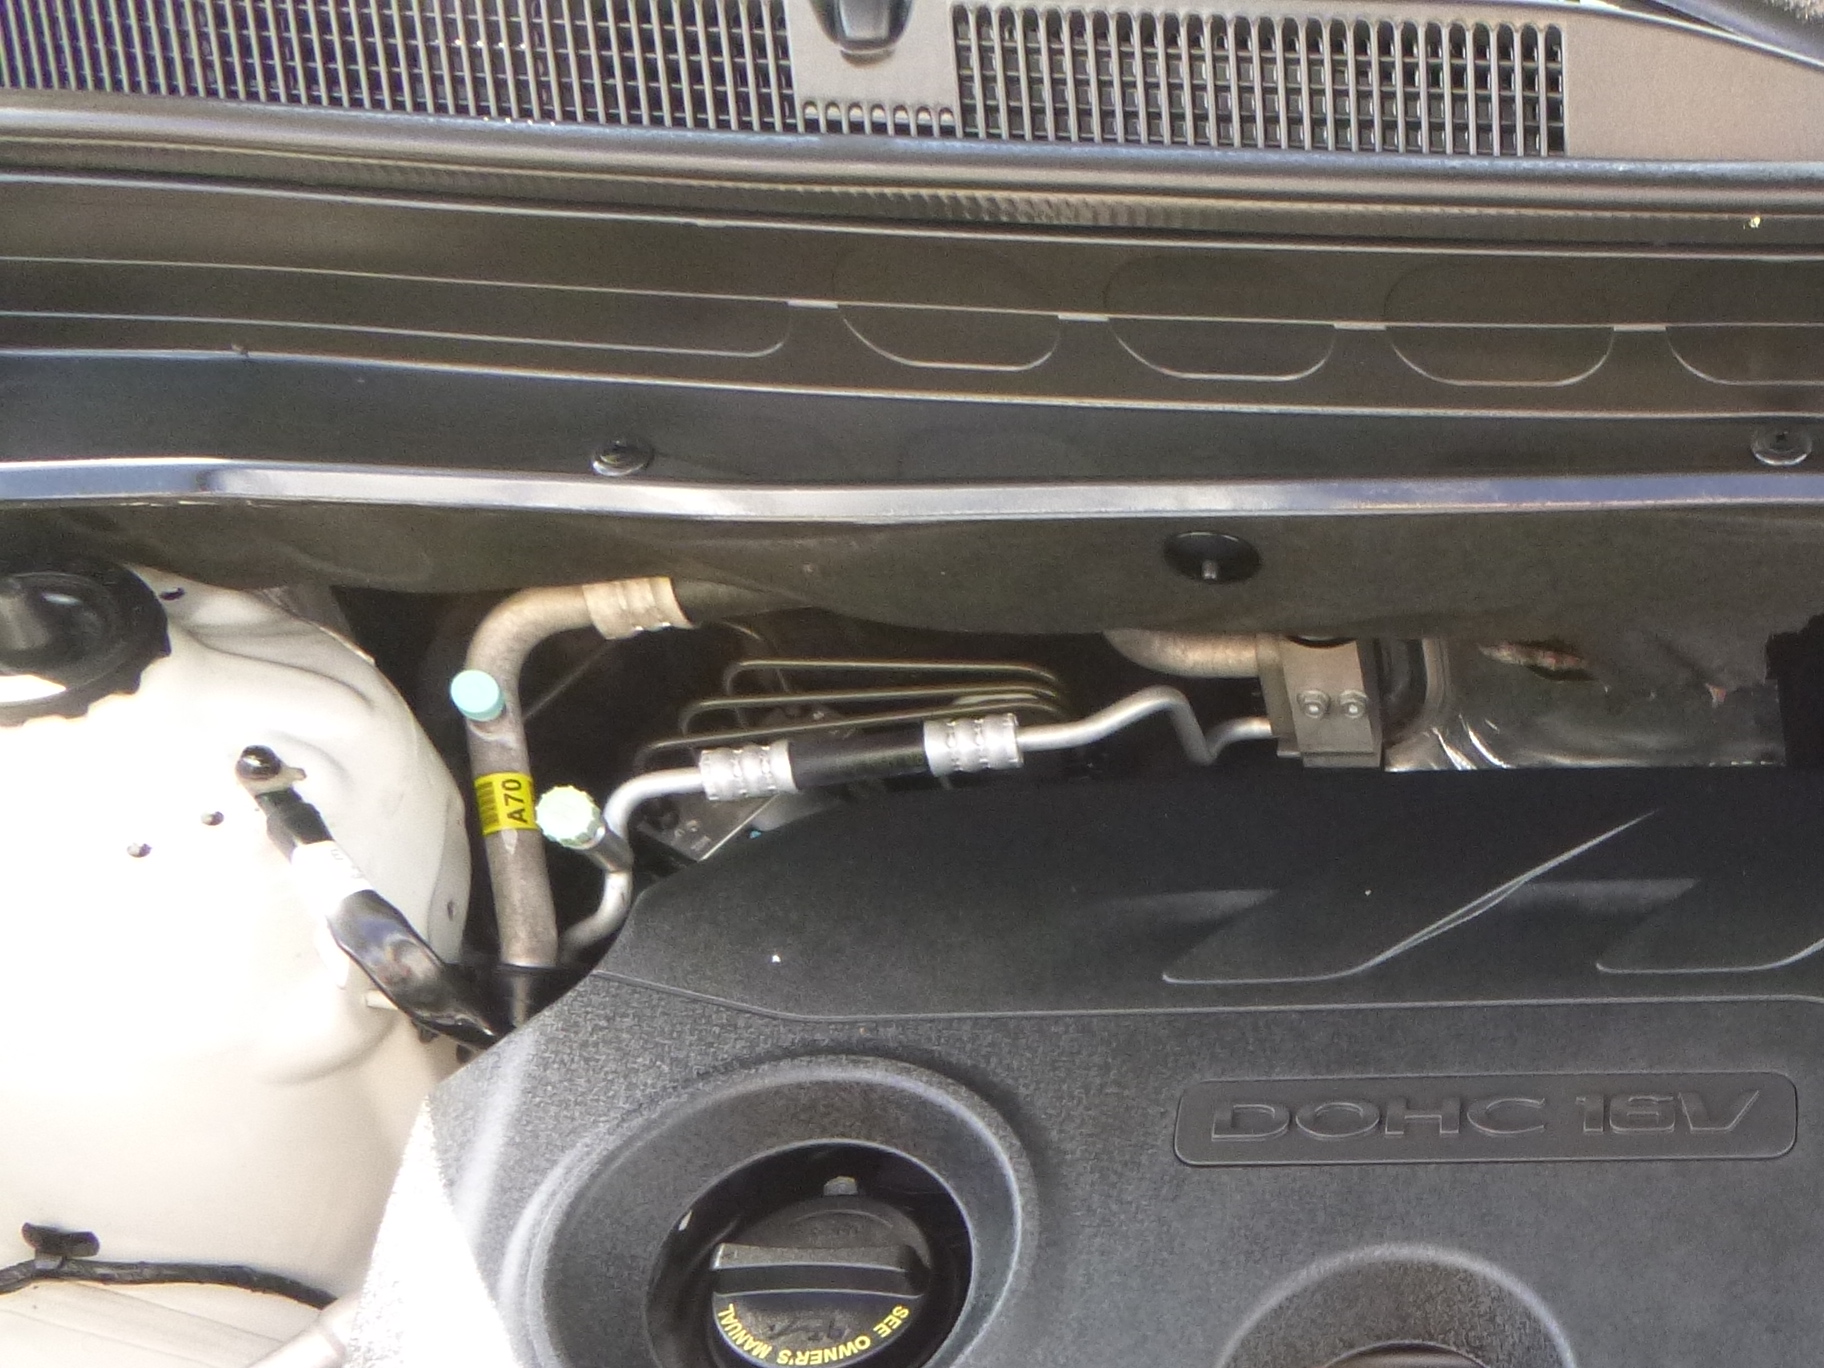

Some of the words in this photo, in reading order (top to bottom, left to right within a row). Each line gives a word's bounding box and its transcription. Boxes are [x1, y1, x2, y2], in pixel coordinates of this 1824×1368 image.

[501, 778, 528, 824] A70
[1210, 1095, 1548, 1141] DOHC
[1575, 1089, 1761, 1134] 16V
[717, 1303, 773, 1360] MANUAL
[873, 1305, 909, 1338] SEE
[776, 1335, 871, 1366] OWNER'S
